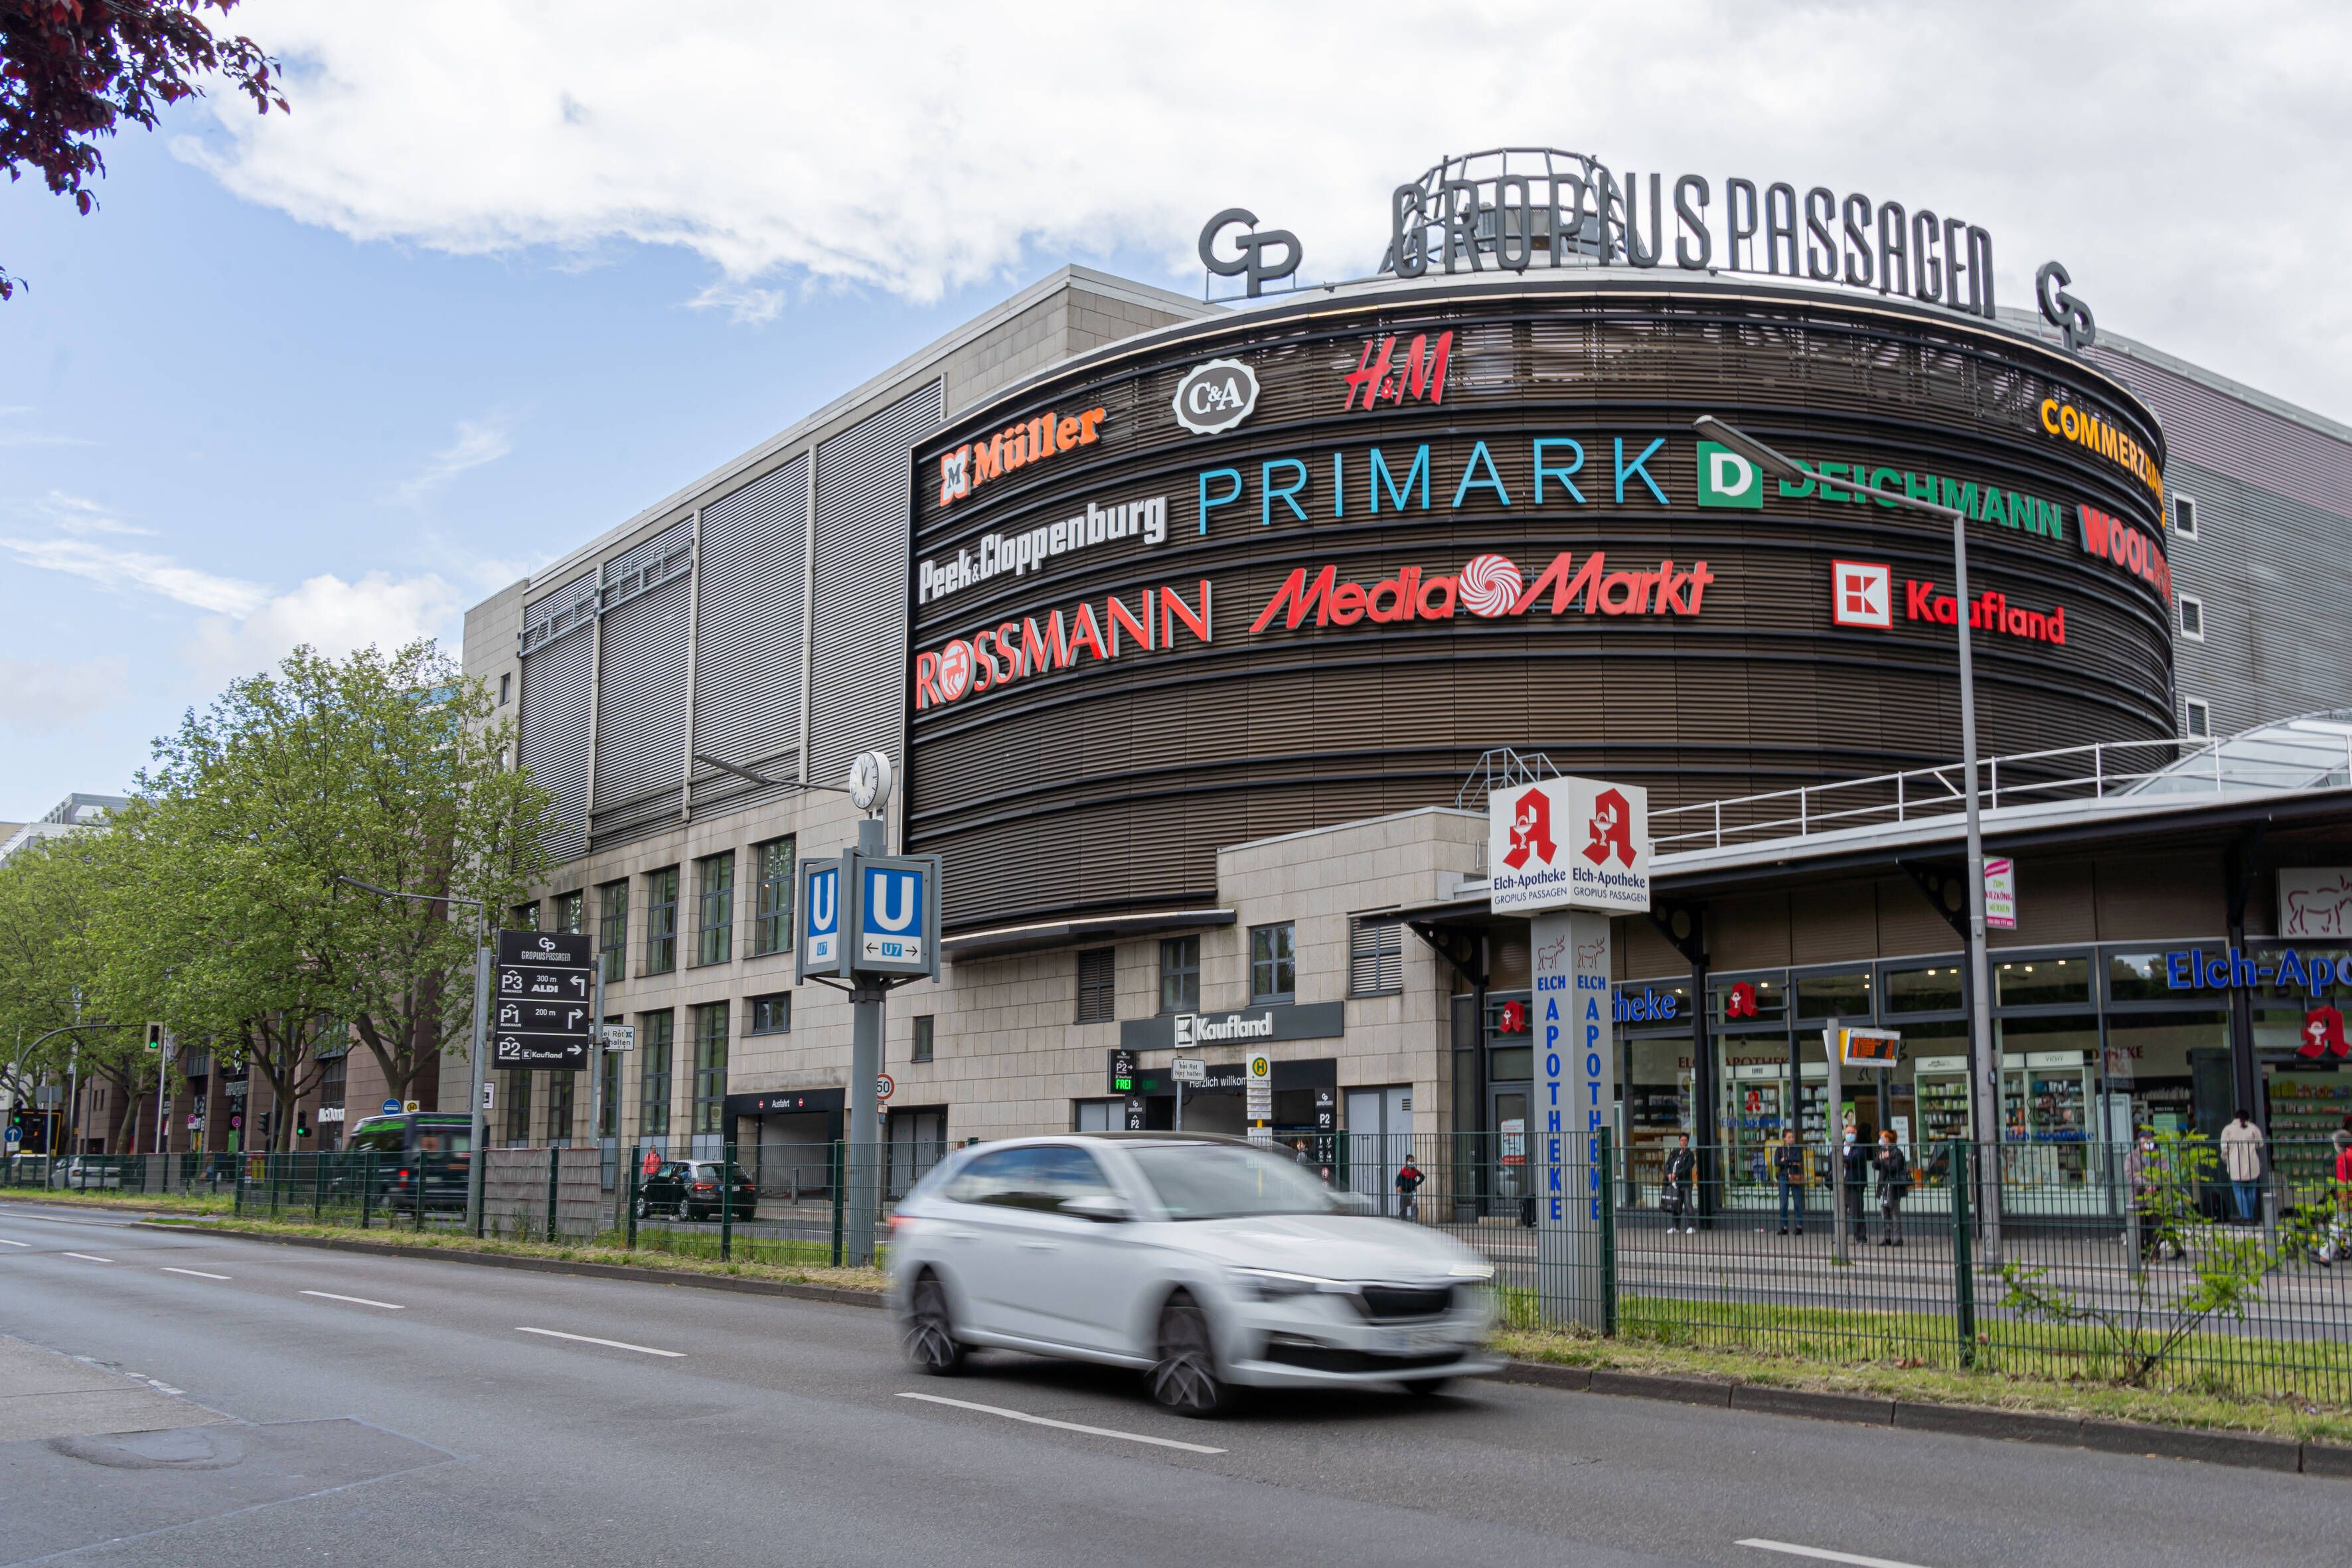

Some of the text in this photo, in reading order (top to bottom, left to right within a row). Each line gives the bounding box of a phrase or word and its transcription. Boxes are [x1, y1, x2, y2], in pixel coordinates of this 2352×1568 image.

[1344, 331, 1453, 411] H&M
[1188, 377, 1244, 416] C&A
[973, 407, 1107, 487] Müller
[1199, 437, 1670, 536] PRIMARK
[1779, 459, 2063, 540] DEICHMANN
[916, 579, 1212, 710] ROSSMANN
[1494, 868, 1567, 891] Elch-Apotheke
[1573, 868, 1646, 888] Elch-Apotheke
[813, 873, 834, 931] U
[873, 874, 914, 931] U
[1494, 887, 1567, 905] GROPIUS PASSAGEN
[1573, 887, 1647, 903] GROPIUS PASSAGEN
[818, 943, 827, 954] U7
[884, 944, 901, 955] U7
[502, 975, 522, 989] P3
[531, 984, 558, 993] ALDI
[1537, 975, 1567, 991] ELCH
[1577, 975, 1607, 990] ELCH
[501, 1009, 519, 1023] P1
[1197, 1012, 1273, 1041] Kaufland
[499, 1042, 520, 1056] P2
[1116, 1063, 1127, 1072] P2
[877, 1081, 890, 1093] 50
[1116, 1079, 1131, 1089] FREI
[771, 1099, 790, 1108] Ausfahrt
[1131, 1119, 1140, 1129] P2
[1320, 1113, 1330, 1124] P2
